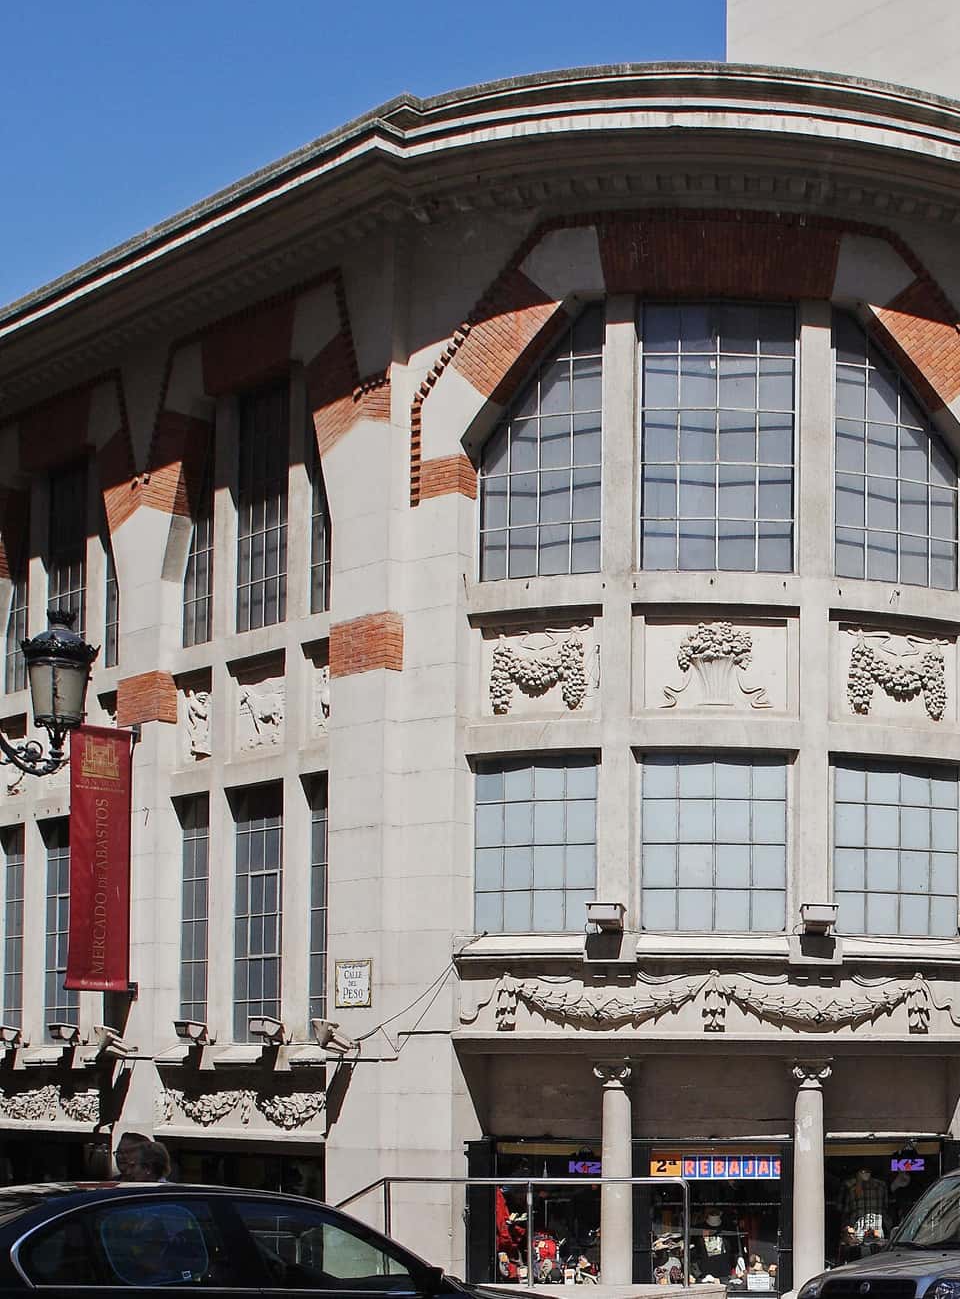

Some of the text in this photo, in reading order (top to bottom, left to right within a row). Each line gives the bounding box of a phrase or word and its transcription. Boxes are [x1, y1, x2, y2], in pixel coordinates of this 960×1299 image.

[95, 798, 110, 871] ABASTOS
[97, 875, 108, 888] DE
[90, 892, 106, 975] MERCADO
[343, 987, 363, 999] PESO
[684, 1160, 780, 1175] REBAJAS
